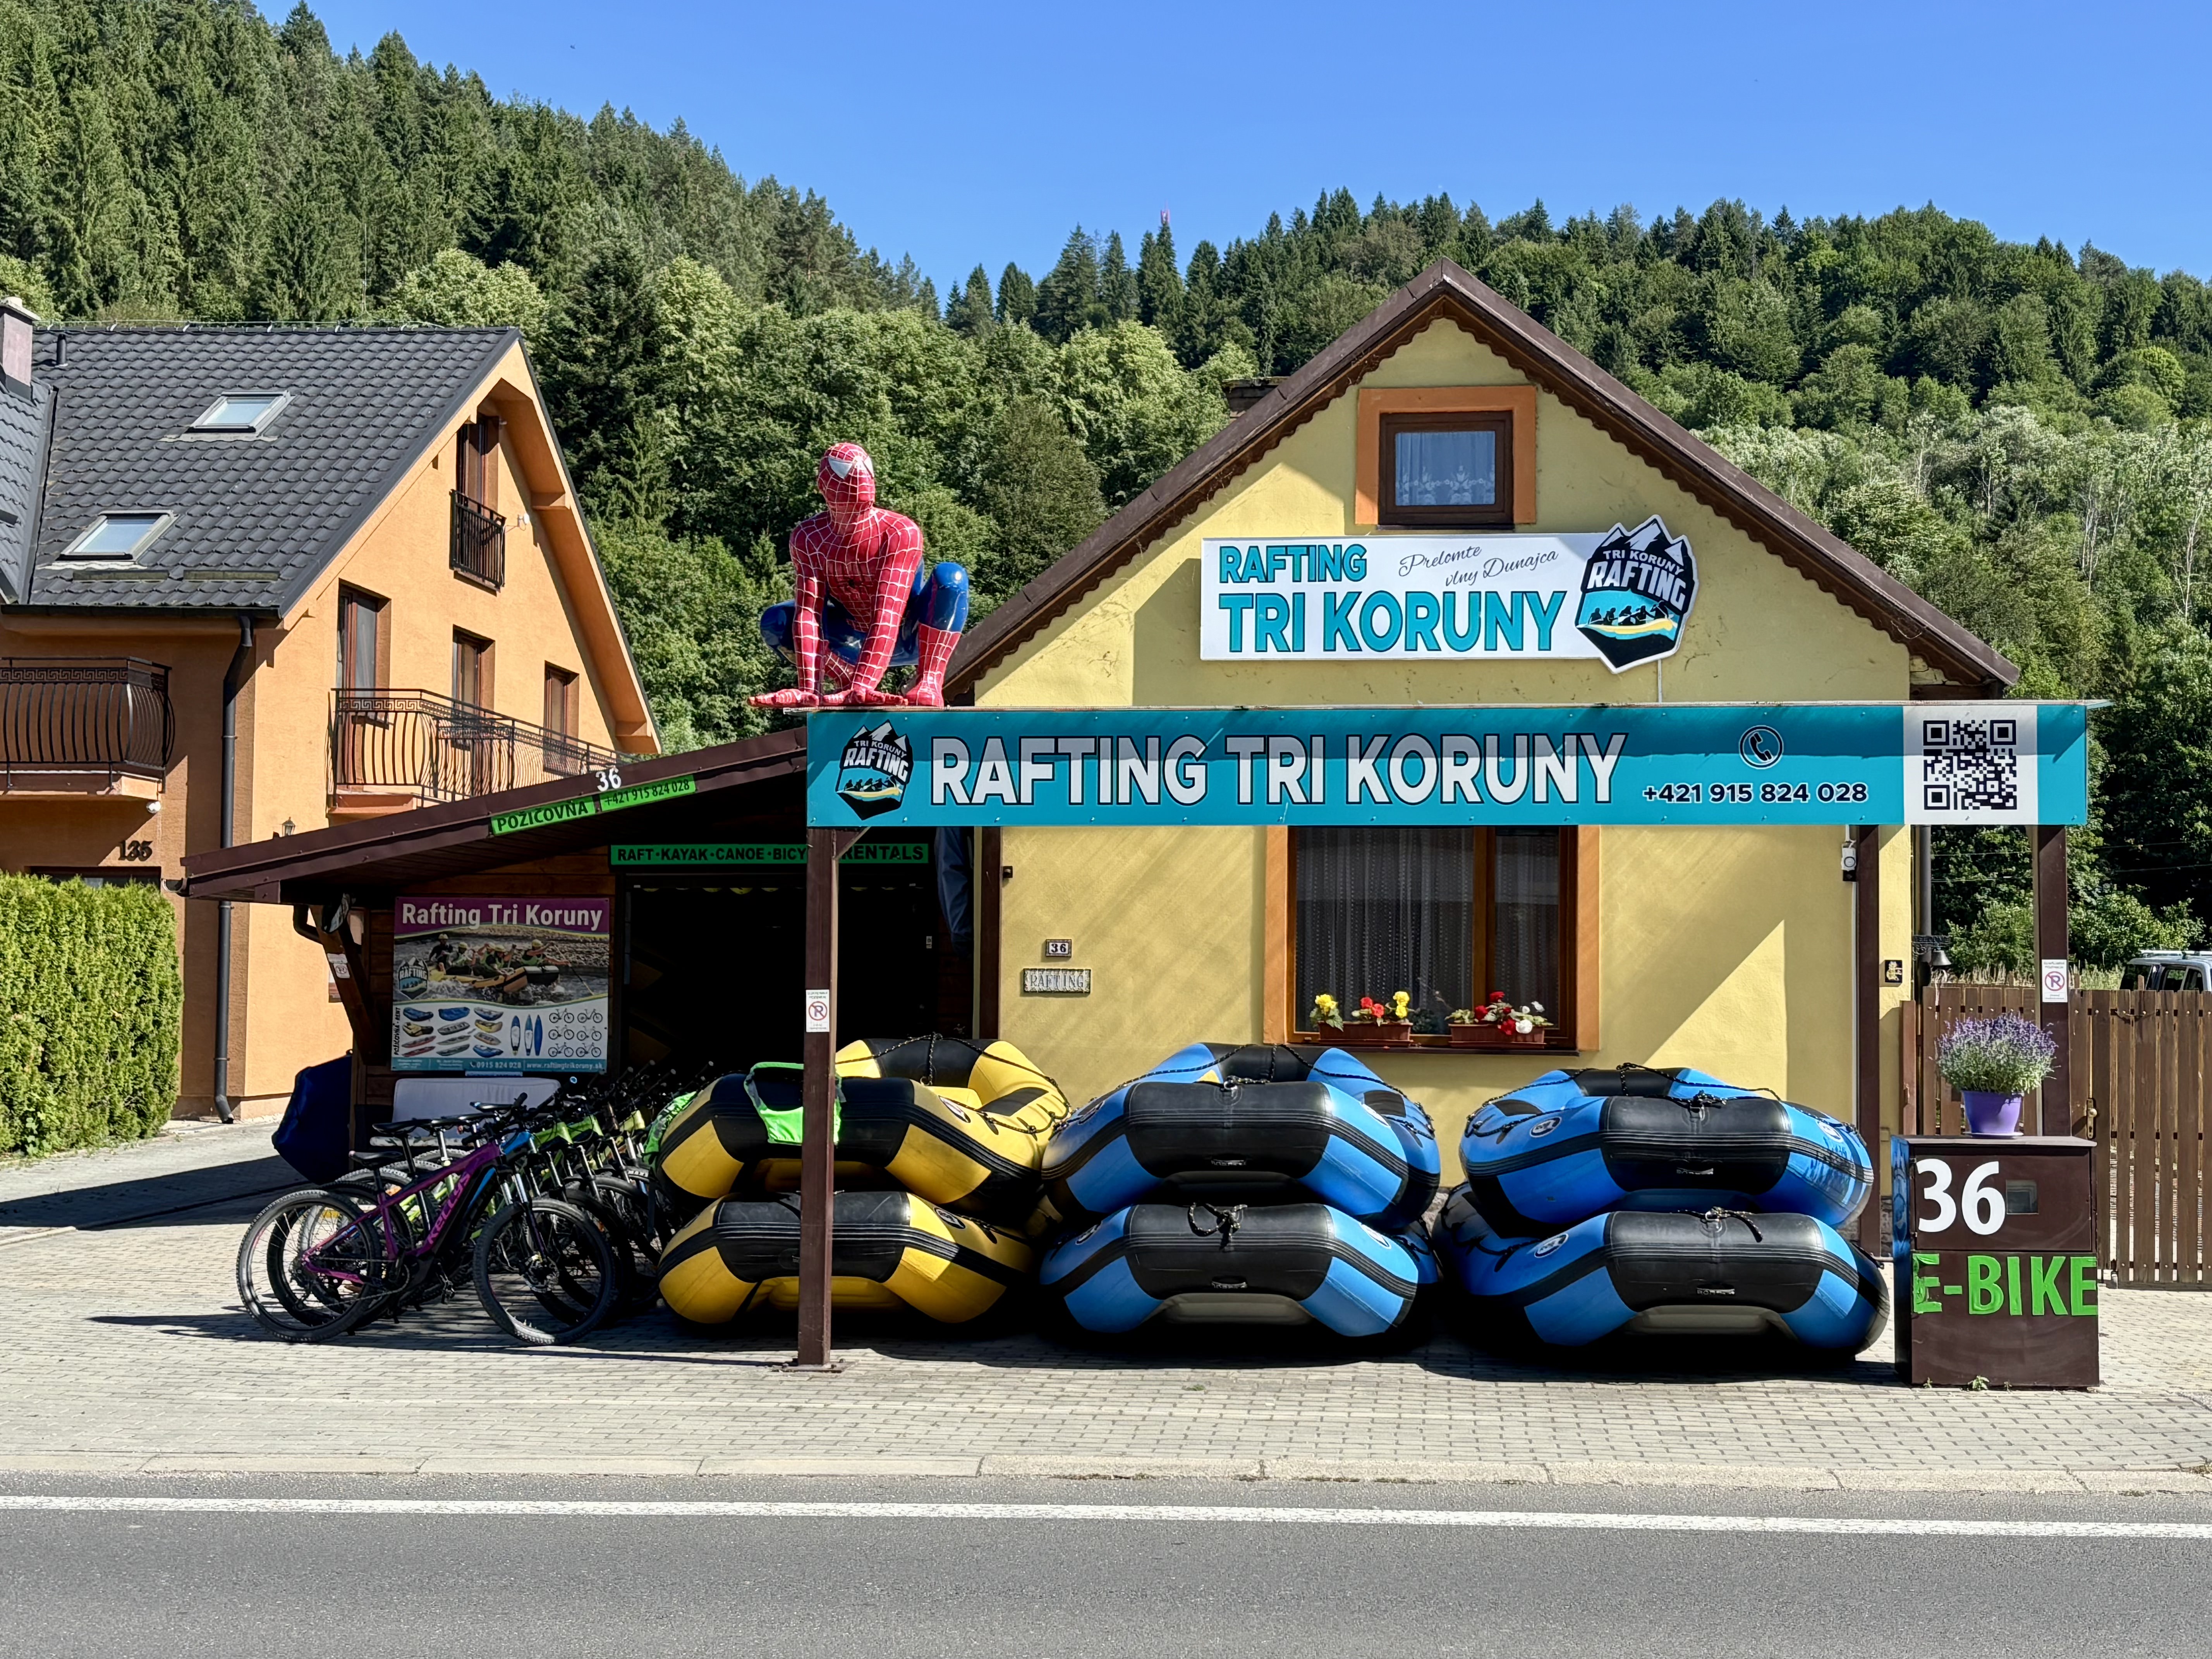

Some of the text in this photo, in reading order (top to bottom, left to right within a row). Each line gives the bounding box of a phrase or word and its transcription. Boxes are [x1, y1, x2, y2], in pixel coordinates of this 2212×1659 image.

[1219, 544, 1367, 583] RAFTING
[1399, 546, 1482, 577] Prelomte
[1446, 551, 1559, 586] vlny Dunajca
[1603, 550, 1684, 575] TRI KORUNY
[1587, 560, 1686, 611] RAFTING
[1219, 590, 1567, 653] TRI KORUNY
[871, 741, 907, 758] KORUNY
[843, 747, 908, 782] RAFTING
[931, 732, 1628, 805] RAFTING TRI KORUNY
[596, 768, 621, 791] 36
[605, 779, 689, 805] +421 915 824 028
[1643, 782, 1869, 803] +421 915 824 028
[496, 800, 588, 831] POŽIČOVŇA
[618, 848, 653, 860] RAFT
[661, 848, 708, 860] KAYAK
[715, 848, 764, 860] CANOE
[773, 848, 807, 860] BICY
[402, 903, 602, 931] Rafting Tri Koruny
[1051, 944, 1066, 953] 36
[399, 968, 428, 980] RAFTING
[1030, 974, 1084, 988] RAFTING
[1915, 1158, 2006, 1235] 36
[1912, 1253, 2098, 1316] E-BIKE
